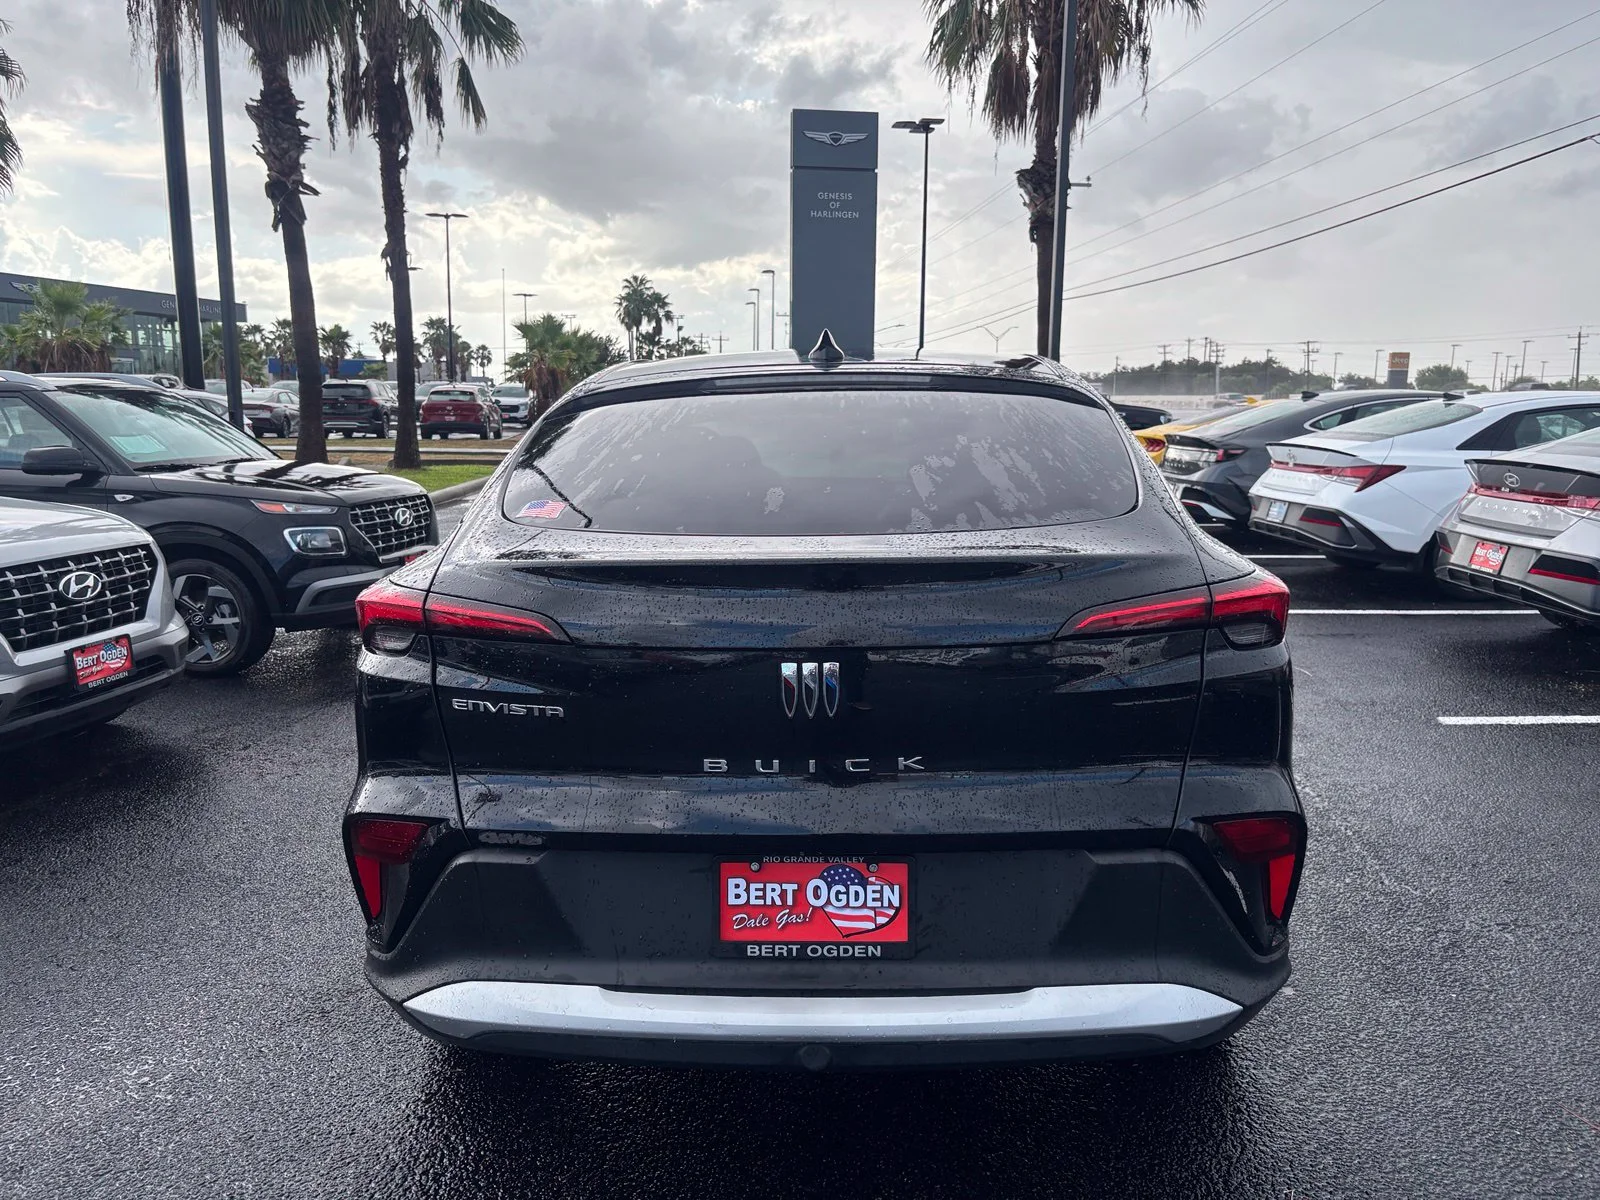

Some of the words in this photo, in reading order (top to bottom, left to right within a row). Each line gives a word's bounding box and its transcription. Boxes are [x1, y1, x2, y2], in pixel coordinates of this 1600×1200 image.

[817, 192, 853, 200] GENESIS
[810, 210, 859, 218] HARLINGEN
[76, 655, 98, 669] BERT
[100, 646, 127, 662] OGDEN
[88, 679, 105, 688] BERT
[106, 671, 128, 682] OGDEN
[452, 698, 564, 718] ENVISTA
[703, 756, 925, 774] BUICK
[763, 855, 781, 864] RIO
[783, 855, 825, 864] GRANDE
[827, 856, 865, 864] VALLEY
[727, 877, 799, 906] BERT
[805, 878, 900, 908] OGDEN
[732, 912, 770, 930] Dale
[775, 907, 813, 930] Gas!
[747, 944, 801, 957] BERT
[806, 944, 882, 958] OGDEN
